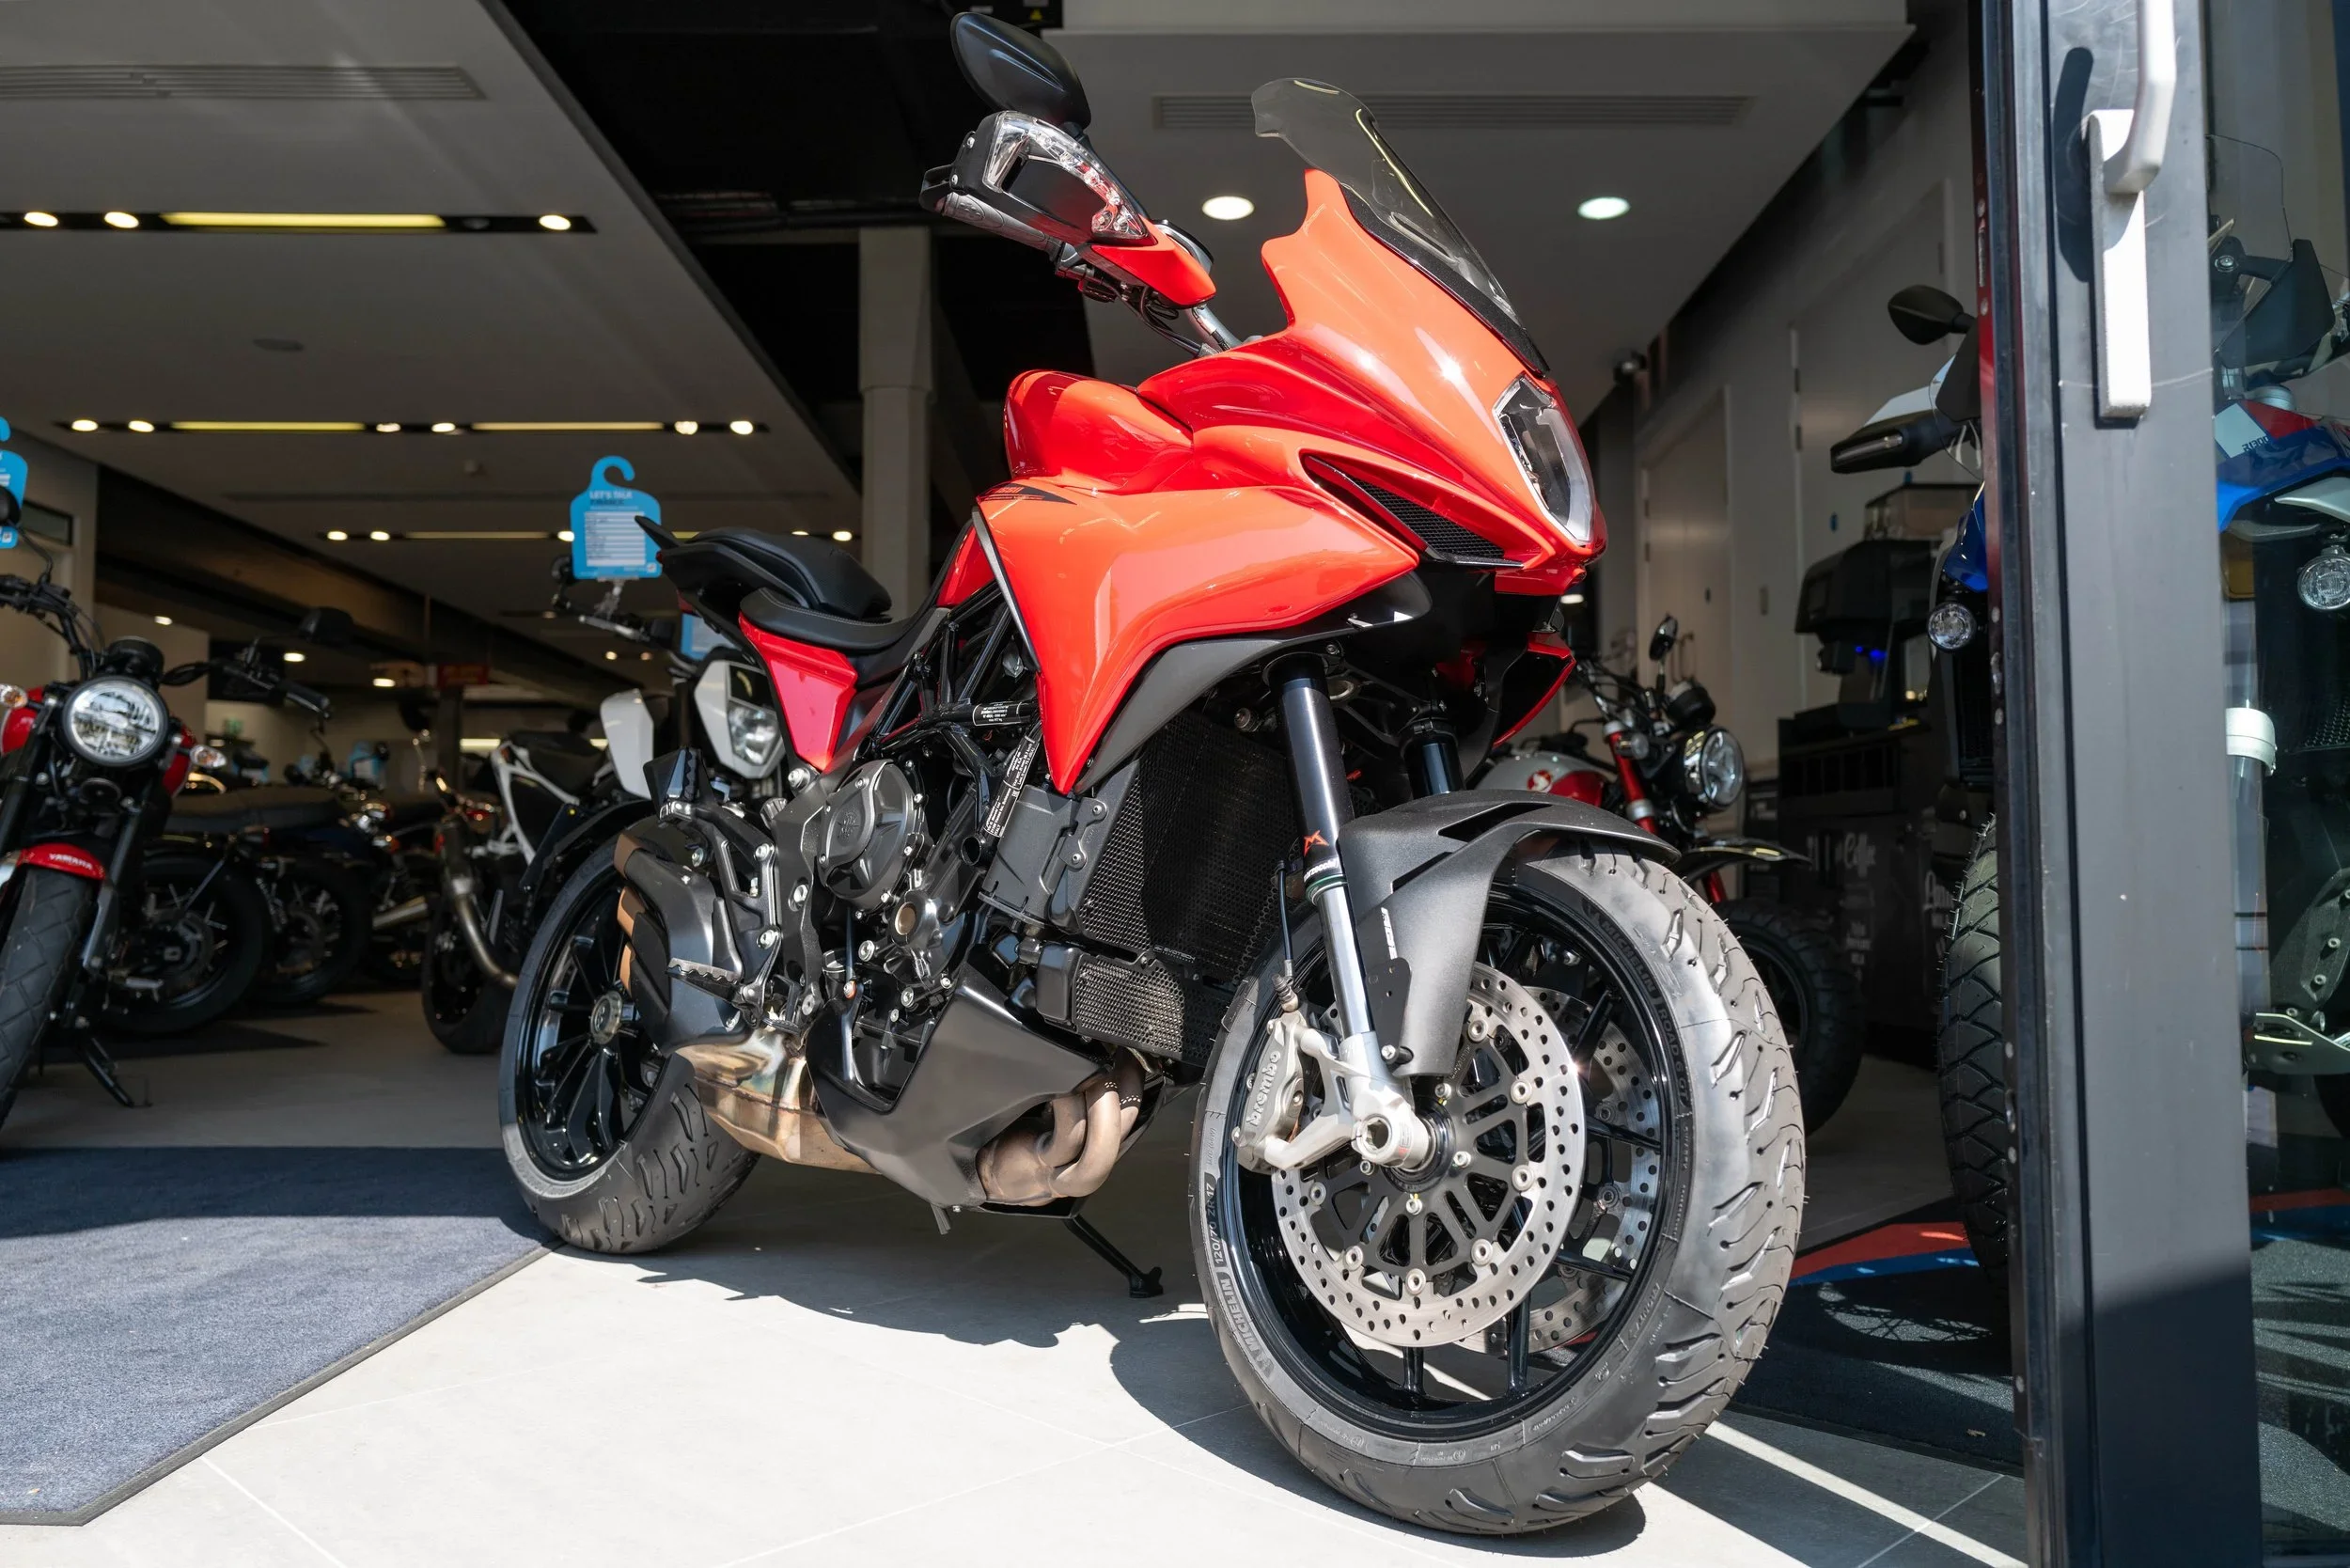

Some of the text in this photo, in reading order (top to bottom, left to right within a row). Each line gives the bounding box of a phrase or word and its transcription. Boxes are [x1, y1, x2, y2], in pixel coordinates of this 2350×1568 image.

[48, 853, 93, 870] YAMAHA
[1601, 918, 1690, 1104] MICHELIN ROAD 6 GT
[1246, 1050, 1281, 1127] brembo
[1206, 1182, 1214, 1197] 17
[1207, 1200, 1215, 1219] ZR
[1209, 1225, 1224, 1264] 120/70
[1219, 1278, 1266, 1353] MICHELIN
